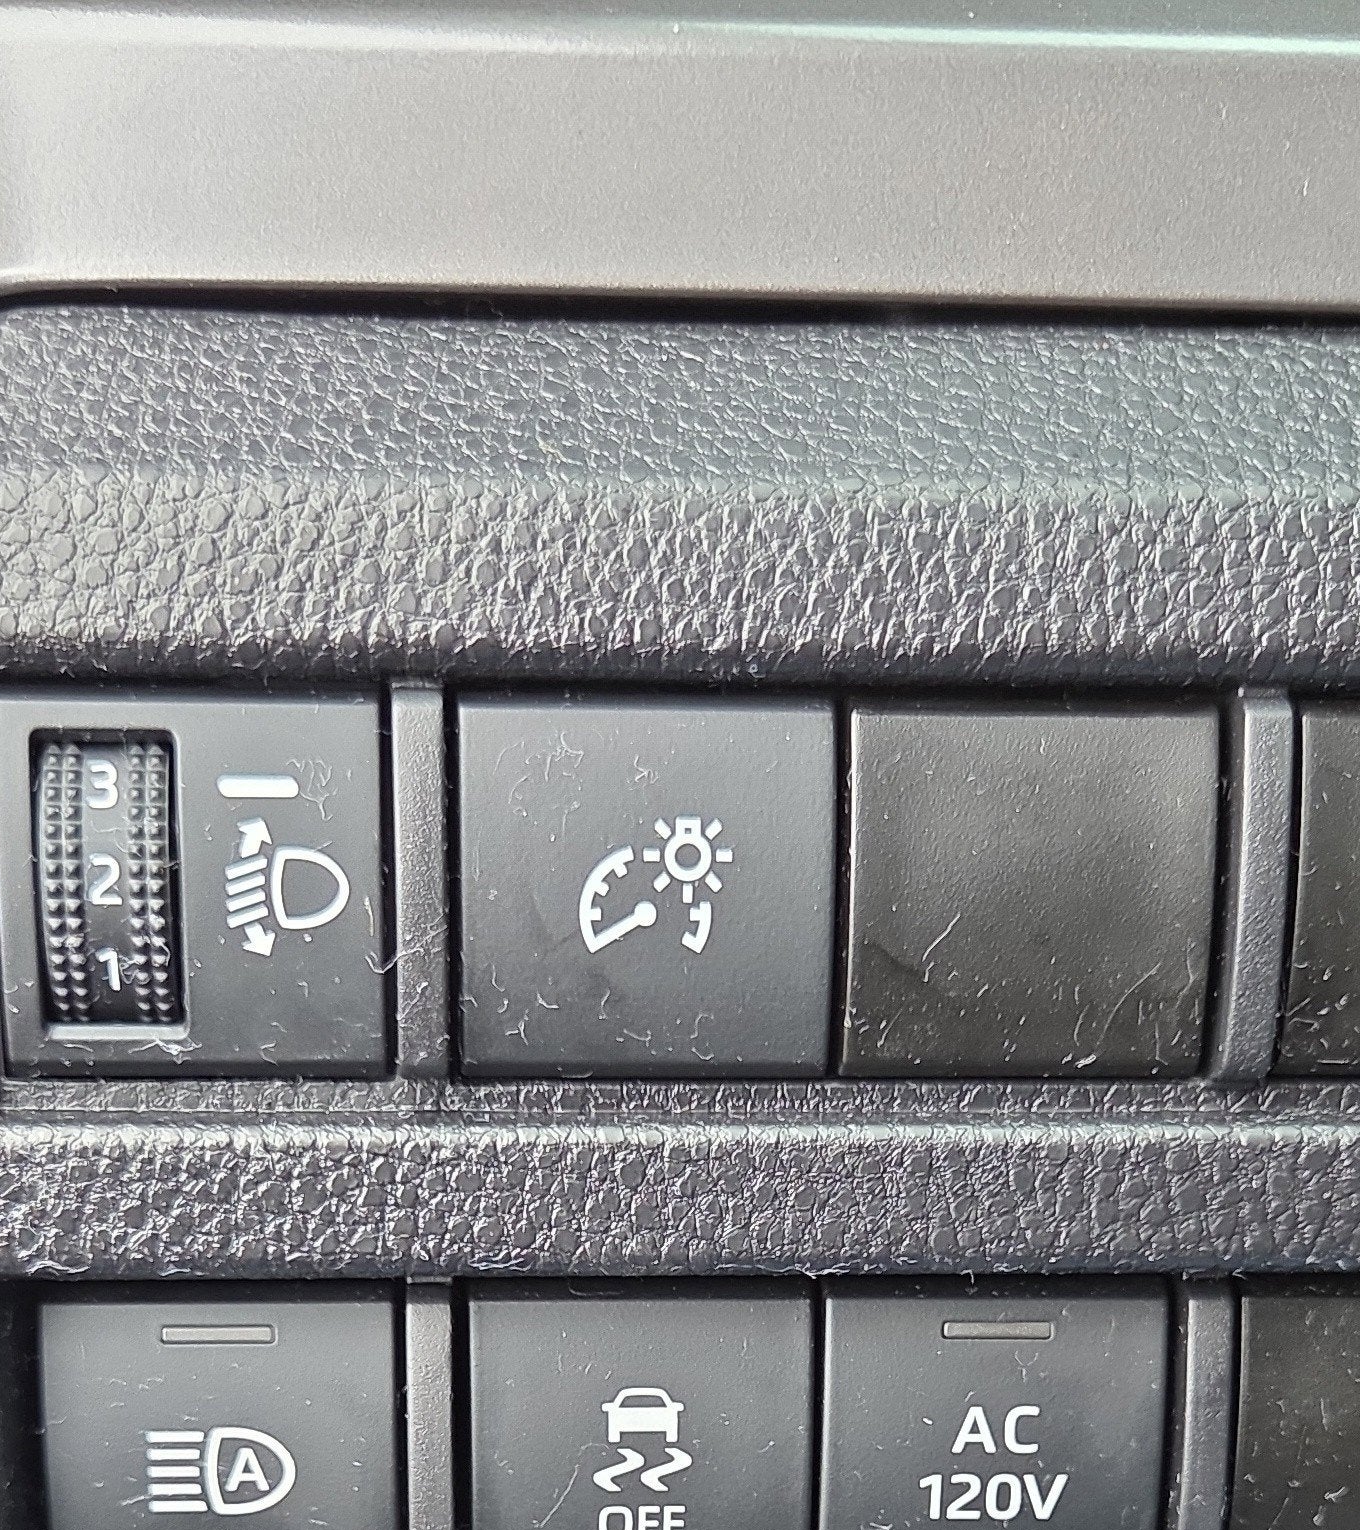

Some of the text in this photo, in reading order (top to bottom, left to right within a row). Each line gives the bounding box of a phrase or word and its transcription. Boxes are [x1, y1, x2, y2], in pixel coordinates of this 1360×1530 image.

[84, 758, 119, 809] 3
[87, 852, 123, 906] 2
[95, 946, 122, 992] 1
[950, 1404, 1041, 1455] AC
[226, 1448, 268, 1491] A
[918, 1472, 1070, 1522] 120V
